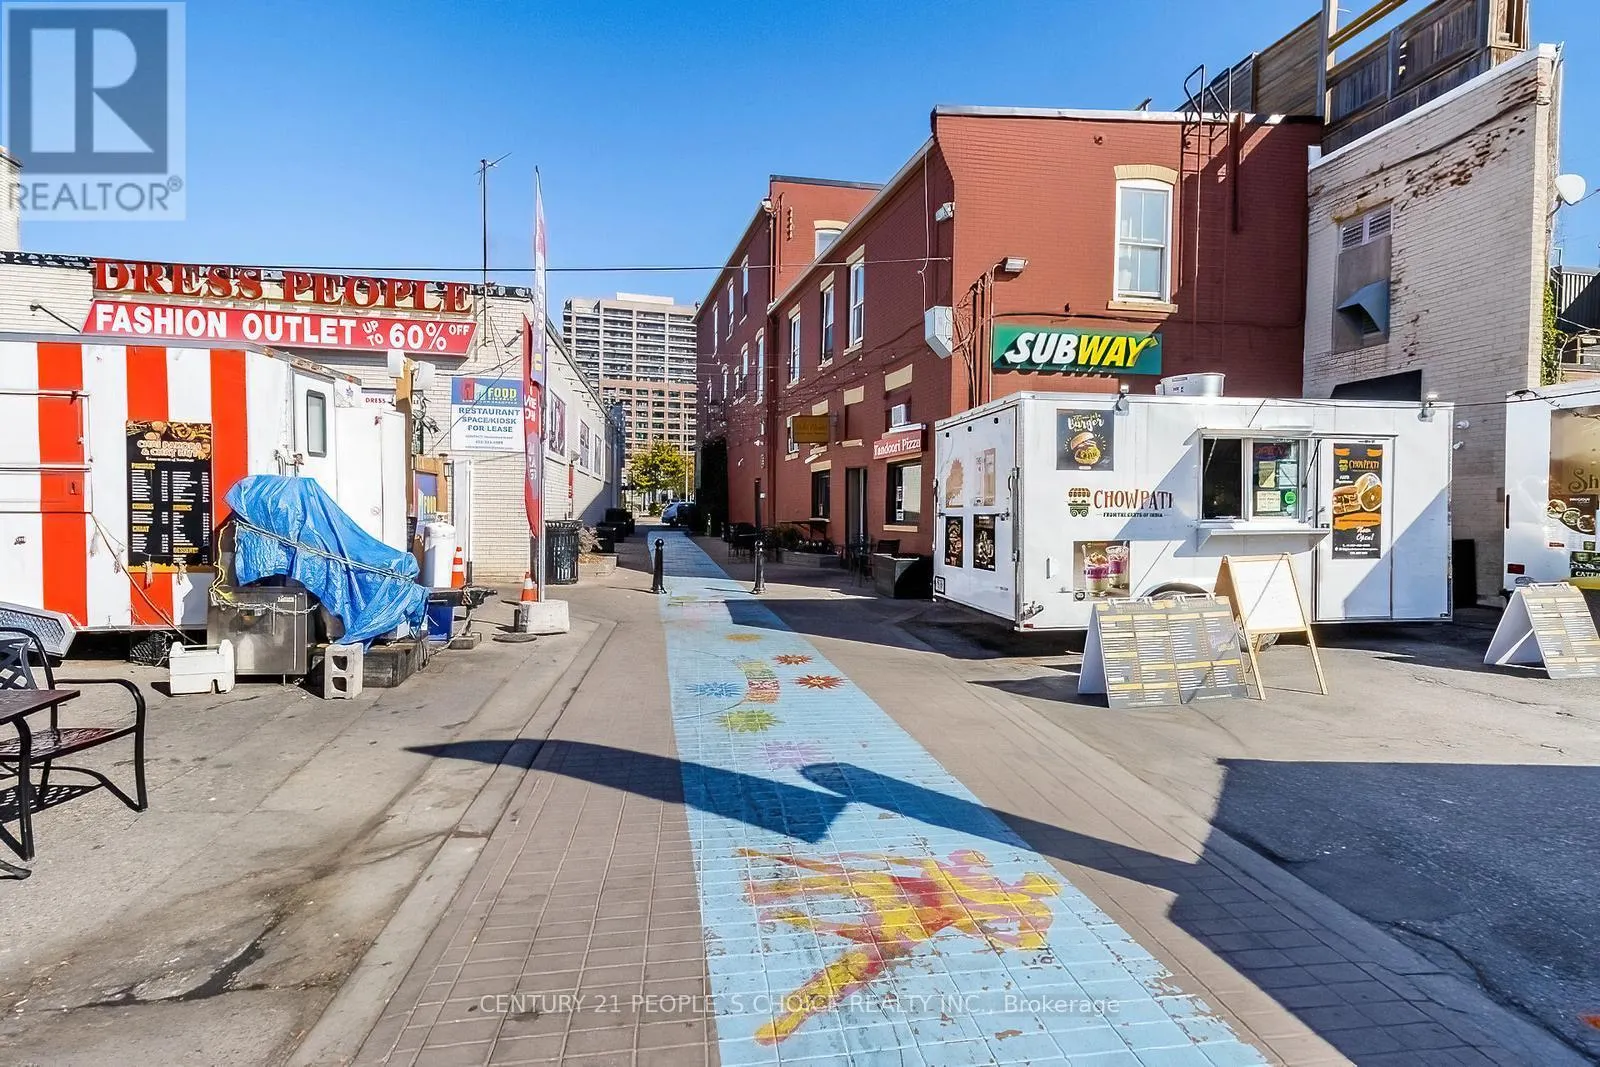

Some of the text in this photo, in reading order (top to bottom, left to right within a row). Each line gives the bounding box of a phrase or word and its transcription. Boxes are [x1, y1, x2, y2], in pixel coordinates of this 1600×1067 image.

[93, 258, 473, 314] DRESS PEOPLE
[96, 304, 470, 351] FASHION OUTLET UP TO 60% OFF
[1004, 331, 1159, 368] SUBWAY
[487, 387, 517, 399] FOOD
[458, 407, 521, 416] RESTAURANT
[467, 424, 513, 433] FOR LEASE
[902, 438, 921, 451] Pizza
